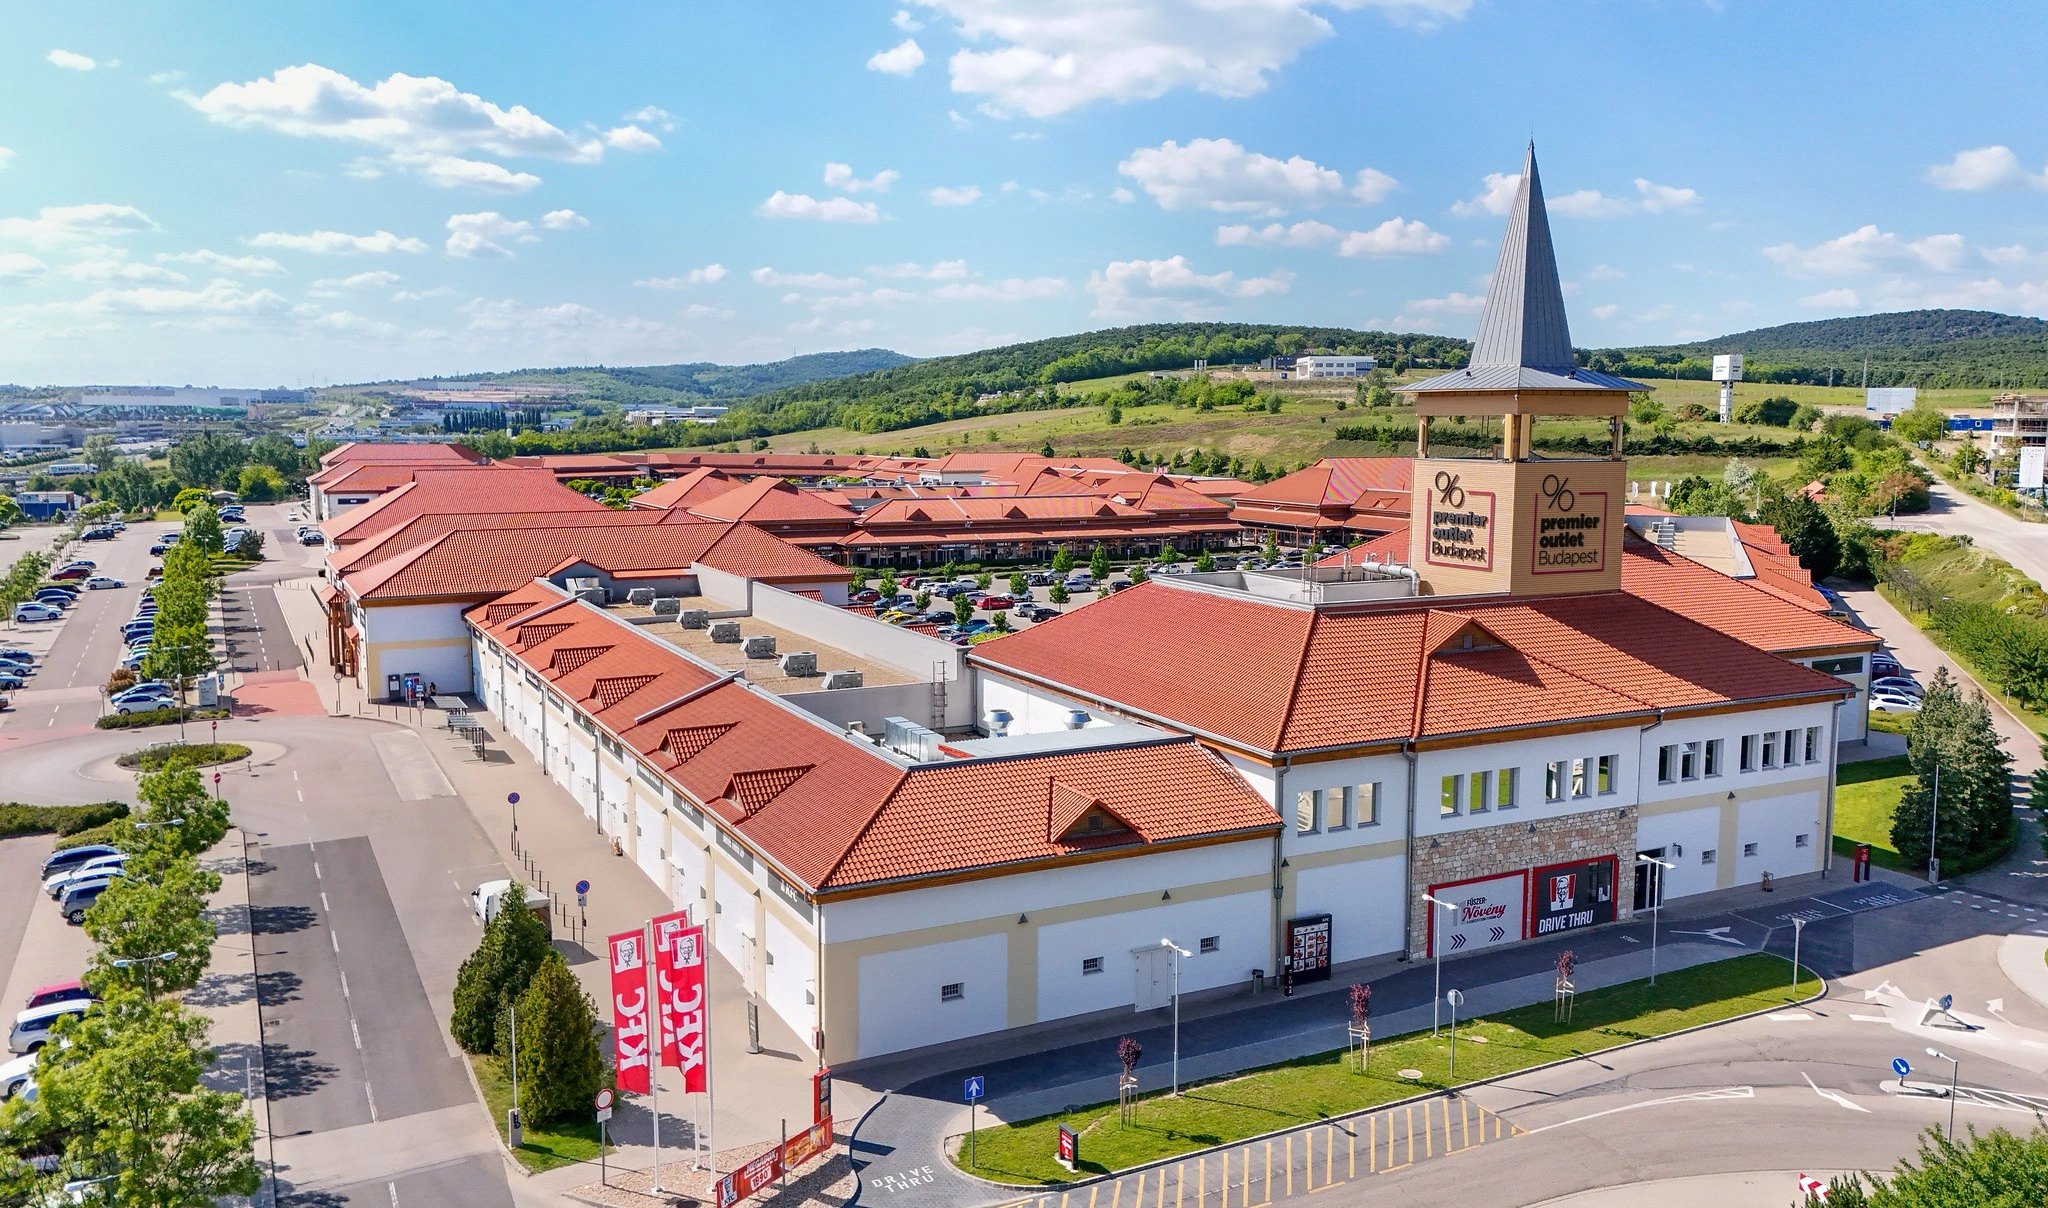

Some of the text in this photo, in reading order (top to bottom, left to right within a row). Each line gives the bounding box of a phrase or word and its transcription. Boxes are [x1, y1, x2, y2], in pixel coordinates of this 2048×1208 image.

[1433, 510, 1488, 528] premier
[1541, 513, 1600, 533] premier
[1432, 526, 1474, 543] outlet
[1540, 531, 1584, 548] outlet
[1432, 541, 1487, 563] Budapest
[1538, 549, 1599, 567] Budapest
[1462, 904, 1507, 921] Növény
[1538, 909, 1594, 934] DRIVE THRU
[616, 986, 648, 1072] KFC
[672, 983, 703, 1075] KFC
[871, 1165, 934, 1188] DRIVE
[884, 1174, 935, 1193] THRU
